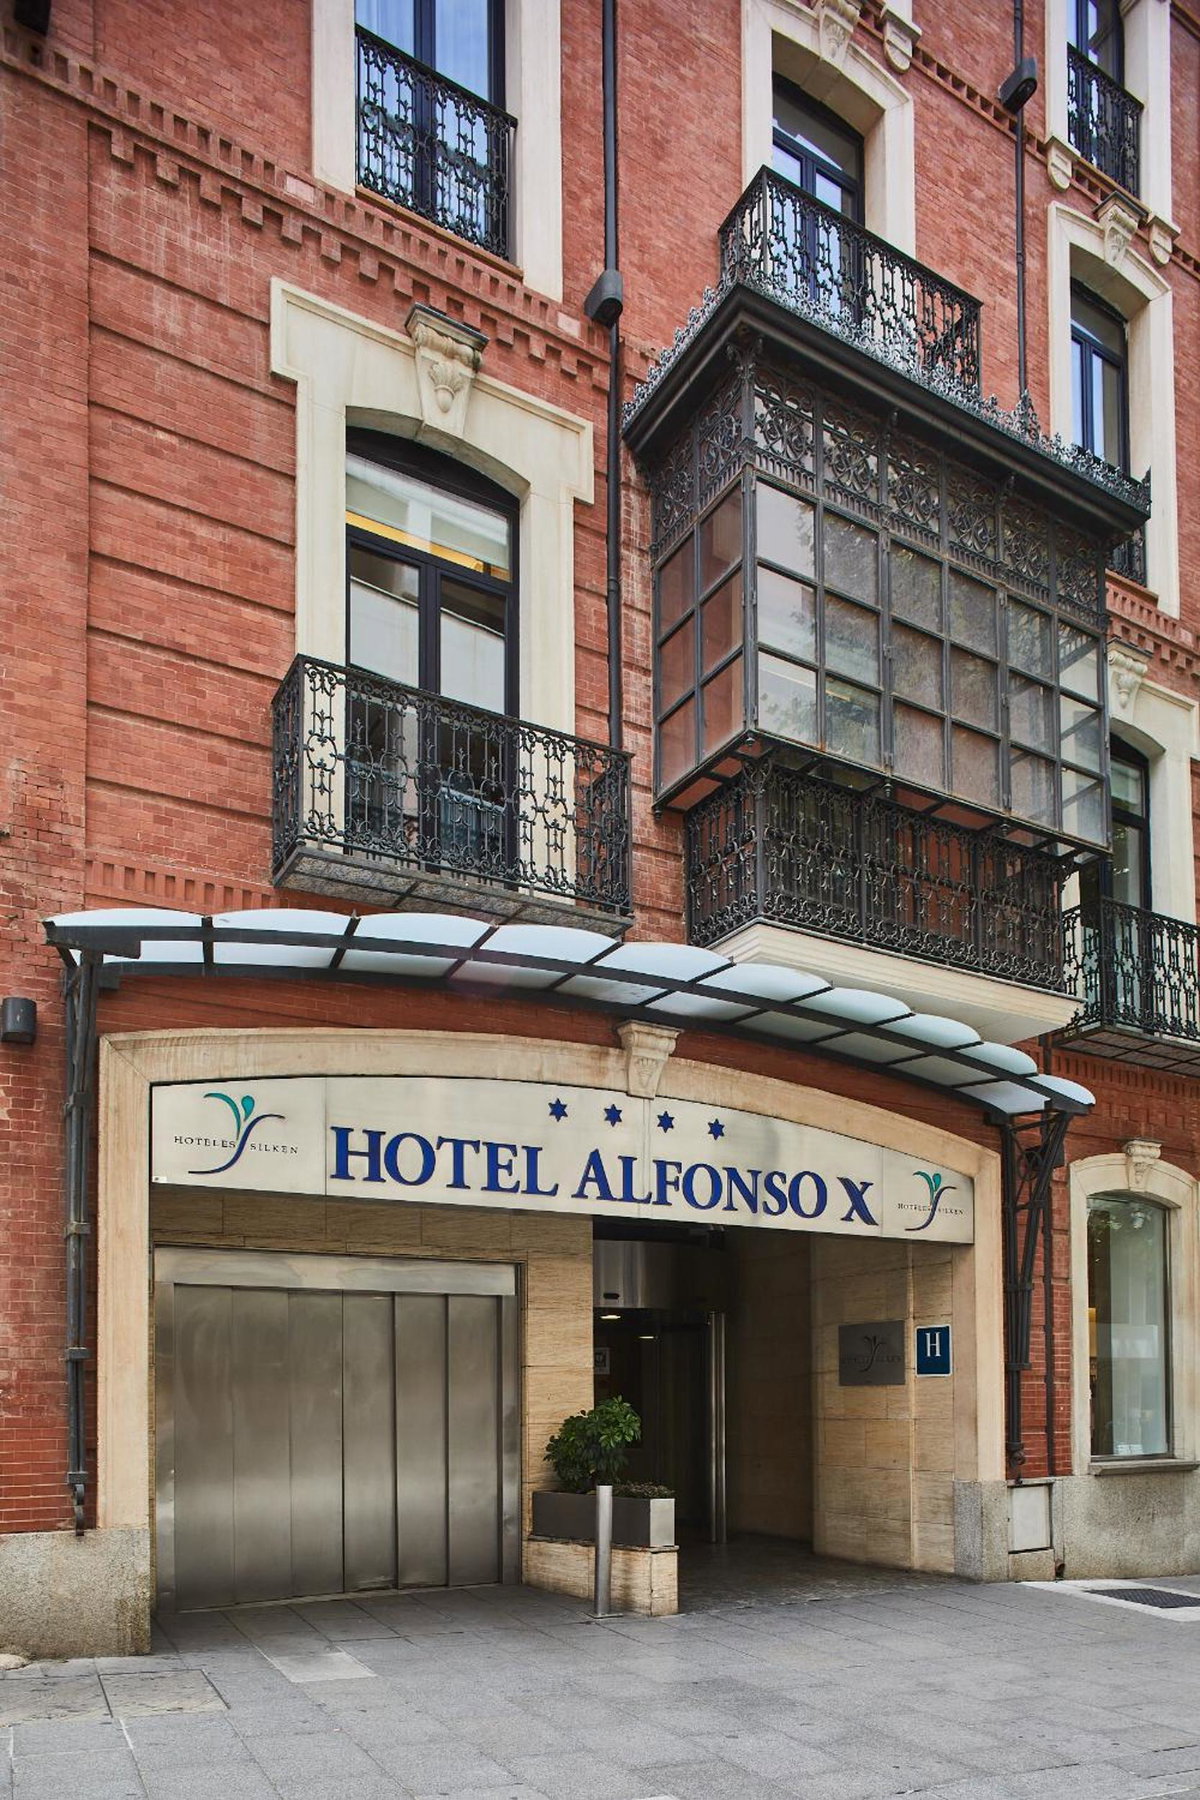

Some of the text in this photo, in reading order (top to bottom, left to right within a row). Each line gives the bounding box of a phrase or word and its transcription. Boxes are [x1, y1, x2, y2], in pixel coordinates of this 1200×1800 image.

[174, 1135, 298, 1154] HOTELES SILKEN
[330, 1126, 879, 1227] HOTEL ALFONSO X
[925, 1331, 941, 1357] H
